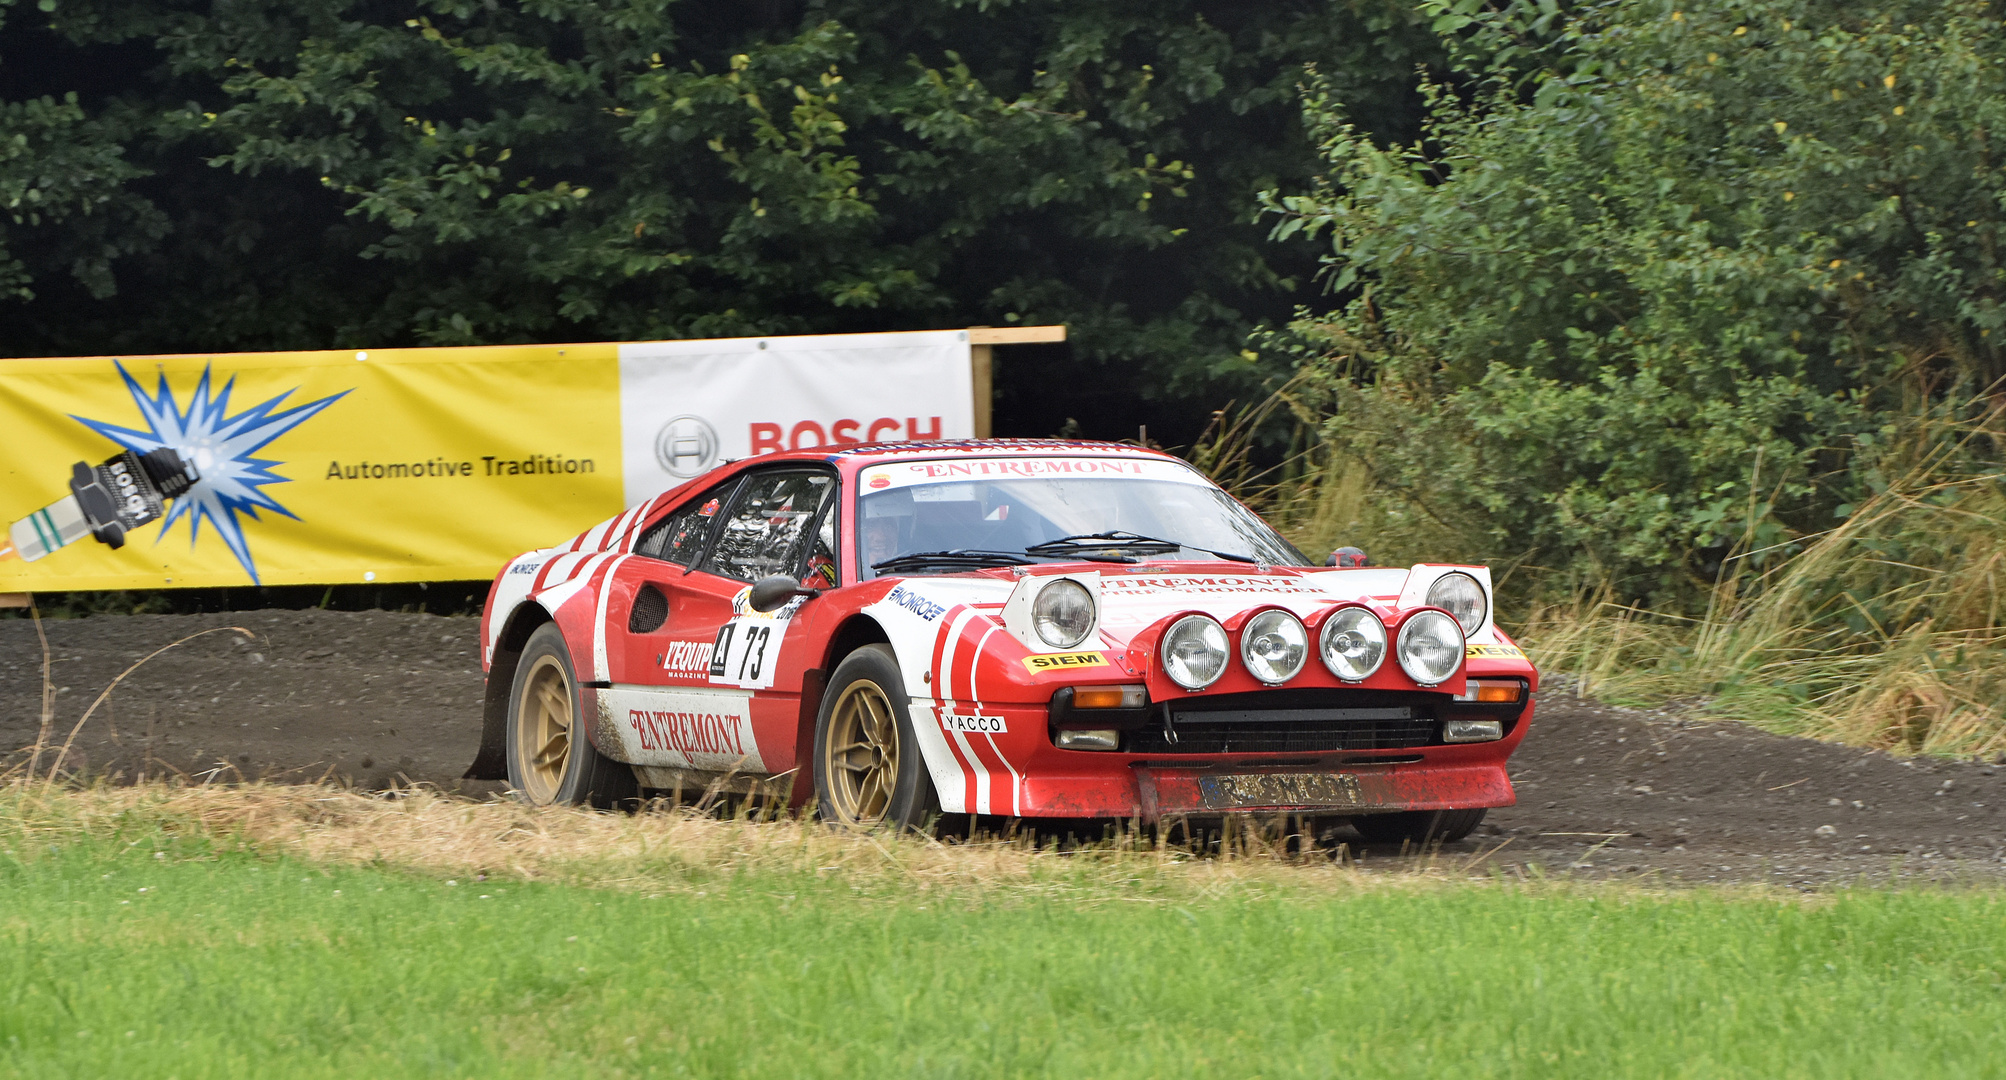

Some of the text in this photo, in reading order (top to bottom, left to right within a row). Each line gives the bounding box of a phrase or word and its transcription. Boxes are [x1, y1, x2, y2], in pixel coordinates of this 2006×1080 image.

[749, 416, 942, 456] BOSCH
[326, 454, 596, 480] Automotive Tradition
[910, 460, 1147, 478] ENTREMONT
[109, 461, 150, 519] BOSCH
[1101, 577, 1299, 590] TREMONT
[889, 587, 941, 621] MONROE
[714, 628, 729, 664] A
[739, 626, 770, 680] 73
[1031, 654, 1100, 667] SIEM
[668, 671, 706, 679] MAGAZINE
[629, 709, 744, 765] ENTREMONT
[946, 715, 1000, 731] YACCO
